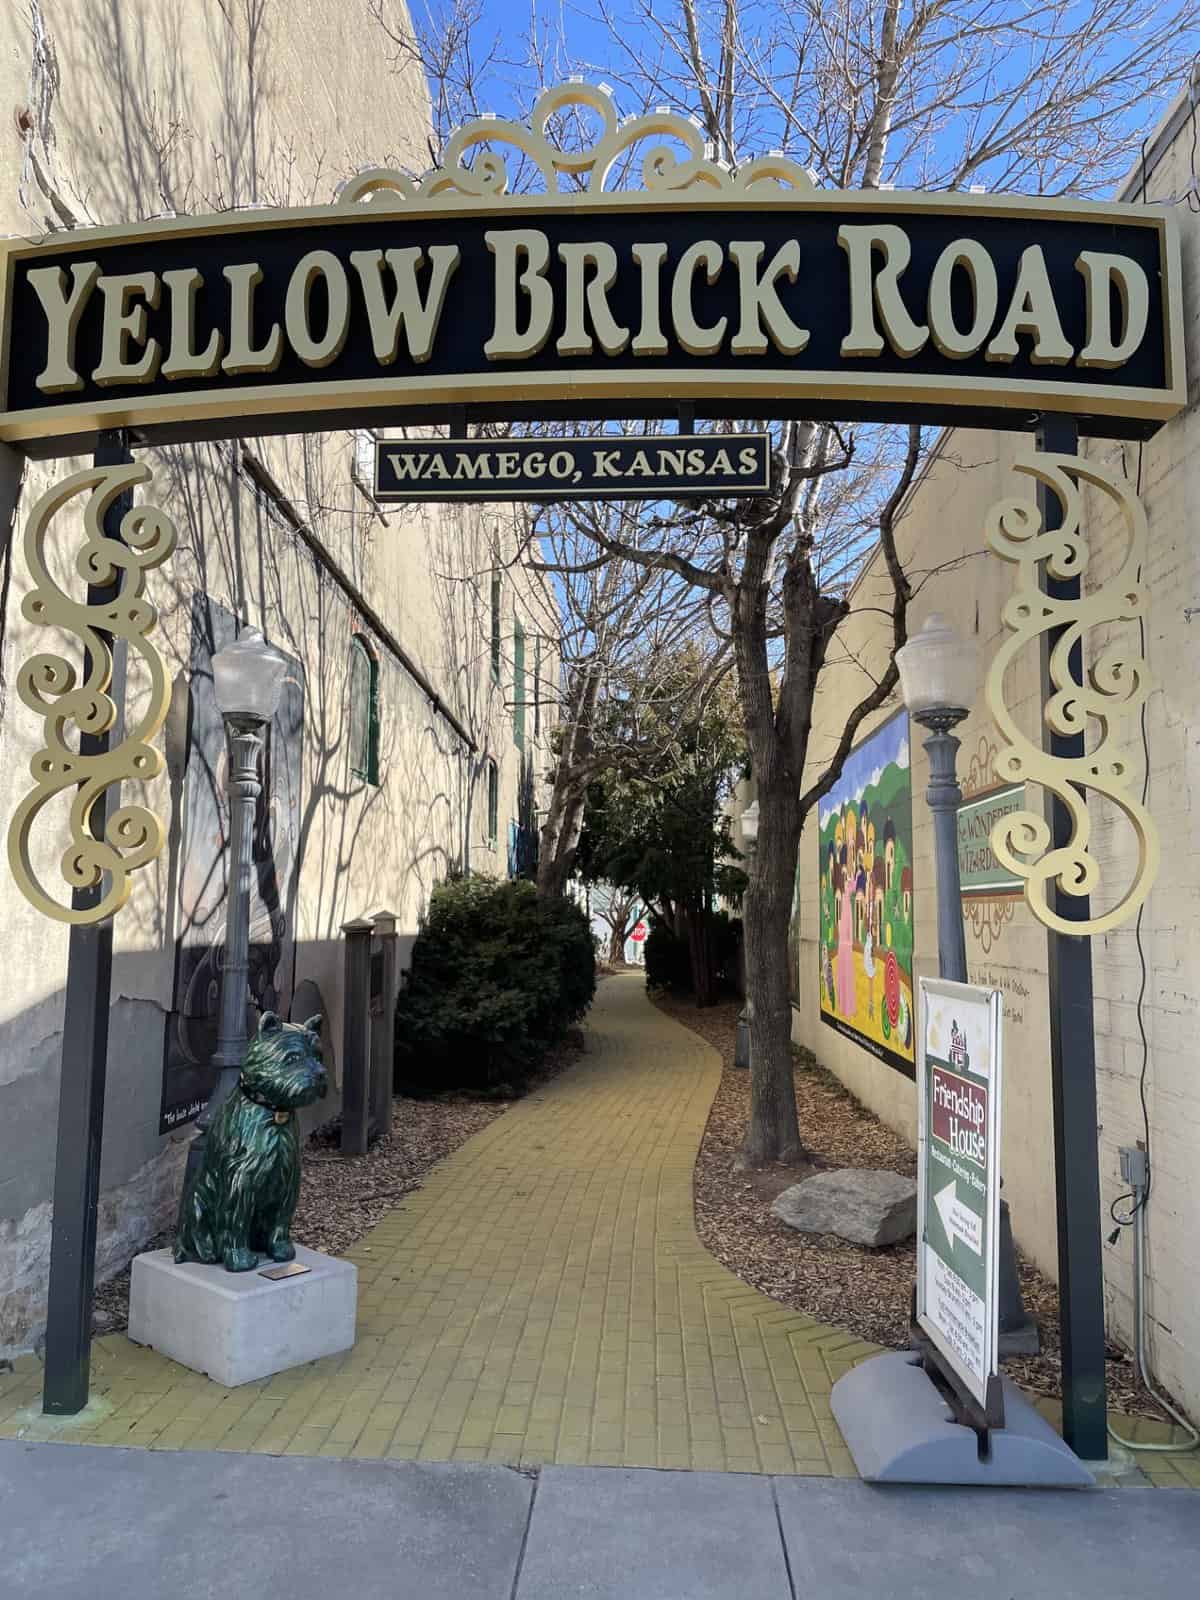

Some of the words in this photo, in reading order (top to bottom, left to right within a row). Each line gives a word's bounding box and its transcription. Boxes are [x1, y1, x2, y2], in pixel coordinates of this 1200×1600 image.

[27, 244, 460, 394] YELLOW
[484, 228, 810, 361] BRICK
[837, 224, 1149, 369] ROAD
[387, 451, 582, 484] WAMEGO,
[592, 447, 759, 478] KANSAS
[933, 1075, 984, 1132] Friendship
[949, 1117, 985, 1160] House
